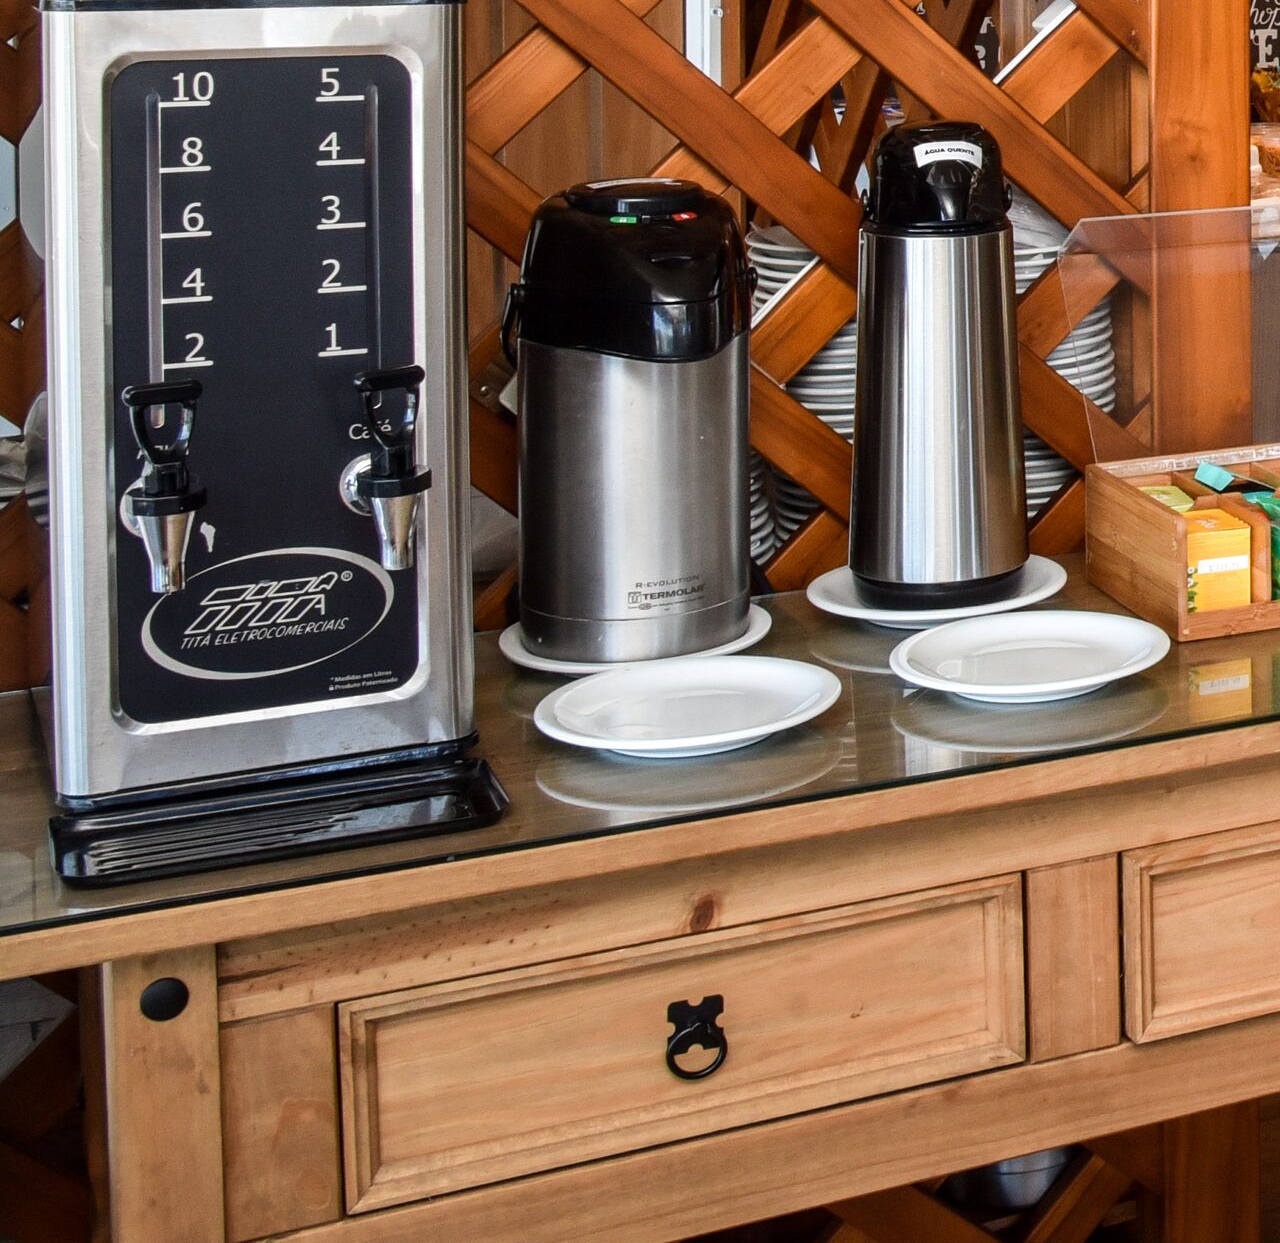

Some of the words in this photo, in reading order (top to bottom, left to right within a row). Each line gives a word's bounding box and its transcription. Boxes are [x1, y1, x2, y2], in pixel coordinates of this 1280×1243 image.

[172, 72, 214, 101] 10
[320, 68, 340, 97] 5
[181, 137, 204, 166] 8
[319, 132, 341, 160] 4
[182, 202, 204, 232] 6
[321, 195, 341, 225] 3
[182, 268, 206, 297] 4
[322, 260, 341, 288] 2
[184, 333, 206, 362] 2
[326, 323, 342, 352] 1
[348, 418, 392, 441] Caé
[635, 575, 699, 588] R-EVOLUTION
[643, 584, 705, 600] TERMOLAR
[215, 618, 349, 646] ELETROCOMERCIAIS
